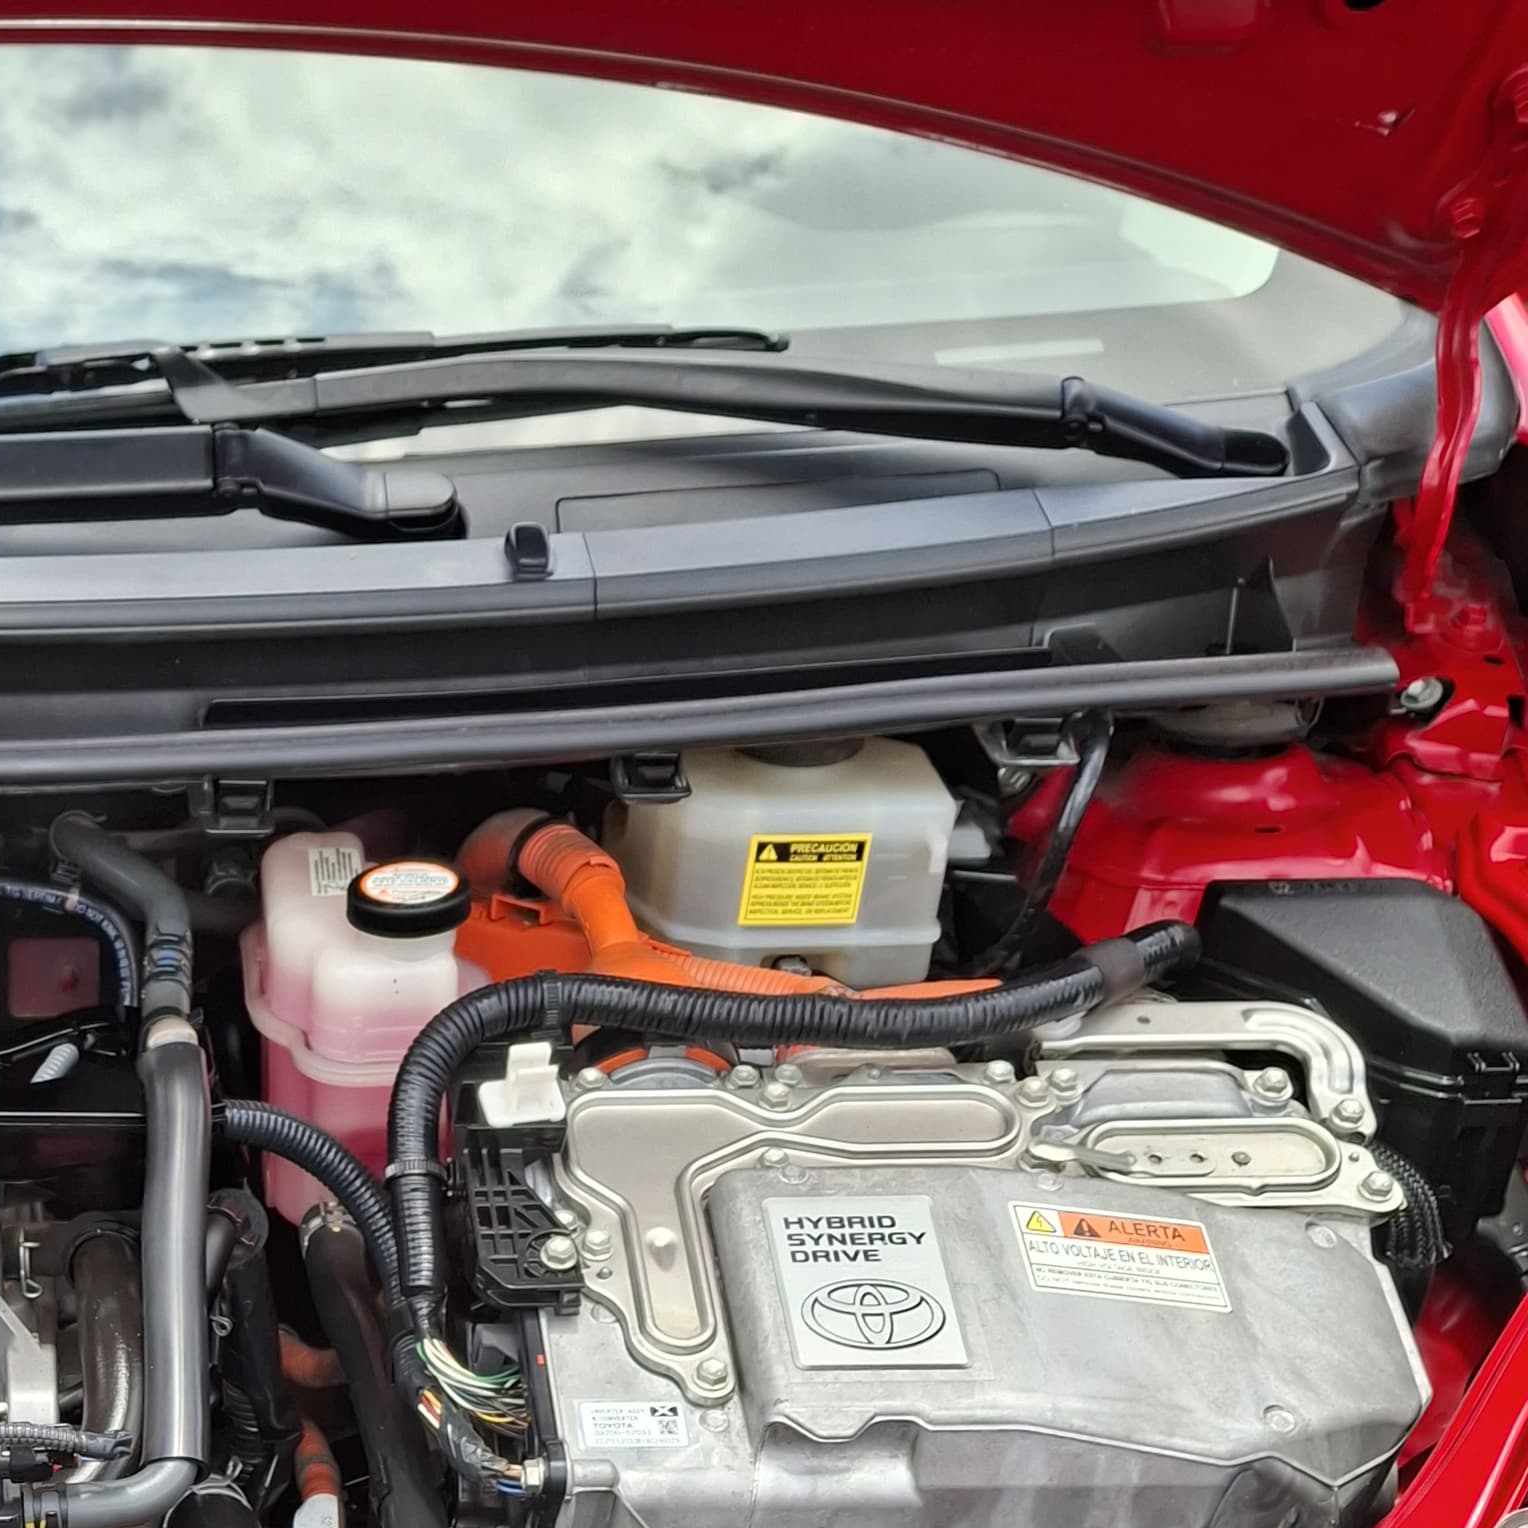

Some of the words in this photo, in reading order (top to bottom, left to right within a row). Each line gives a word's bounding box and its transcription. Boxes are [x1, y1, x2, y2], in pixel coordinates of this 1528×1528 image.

[783, 1215, 897, 1230] HYBRID
[1108, 1220, 1186, 1242] ALERTA
[786, 1232, 928, 1247] SYNERGY
[790, 1249, 883, 1263] DRIVE
[1028, 1240, 1059, 1254] ALTO
[1063, 1243, 1115, 1261] VOLTAJE
[1119, 1250, 1136, 1263] EN
[1138, 1252, 1156, 1266] EL
